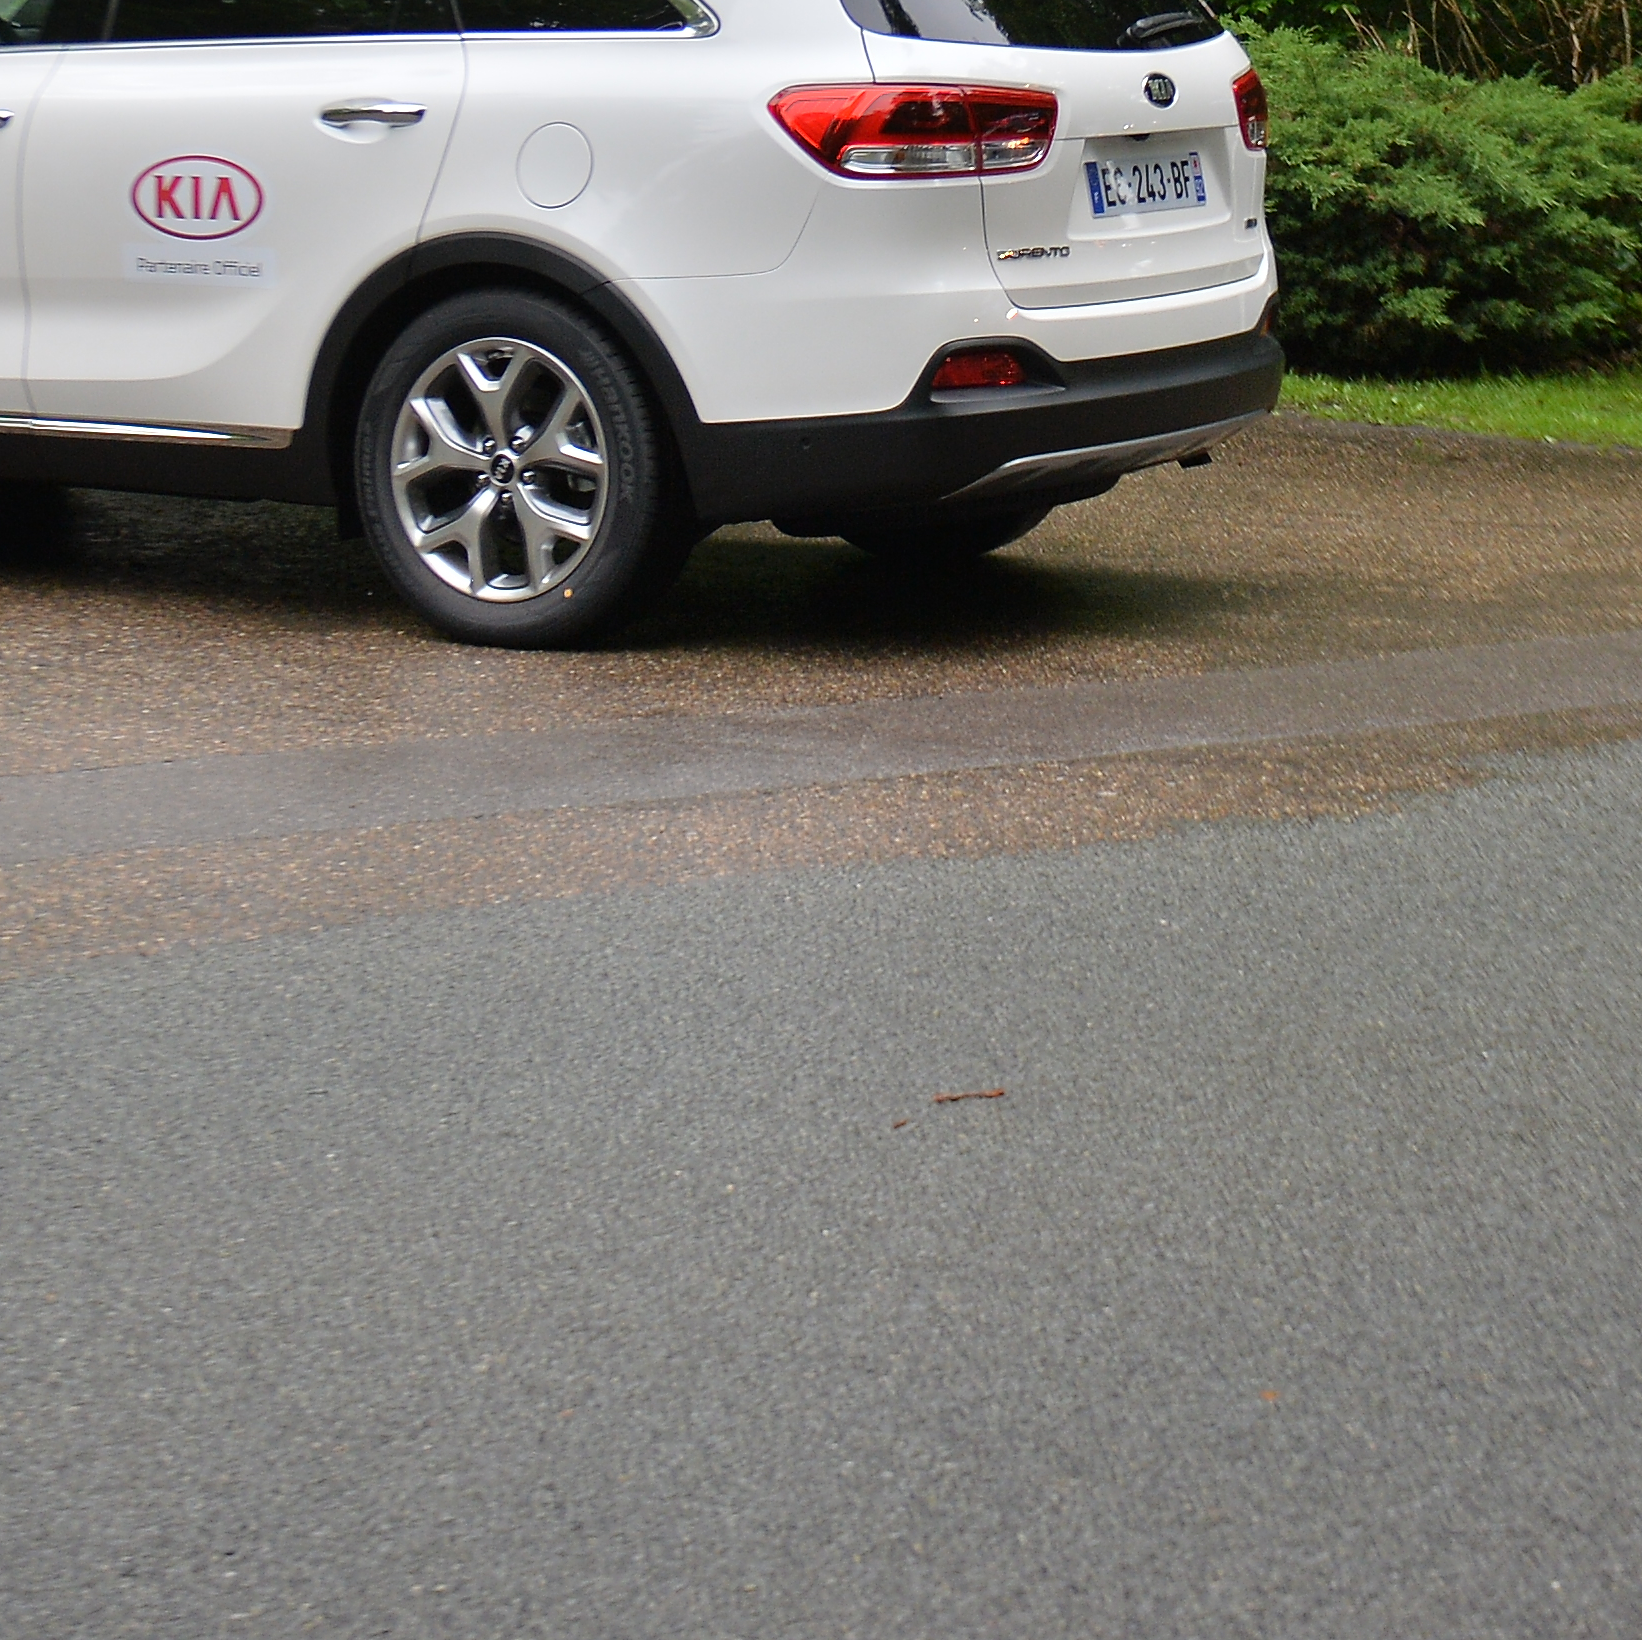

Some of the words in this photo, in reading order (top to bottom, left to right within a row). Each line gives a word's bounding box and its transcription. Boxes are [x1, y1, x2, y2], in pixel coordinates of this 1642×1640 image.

[153, 174, 241, 221] KIA
[136, 257, 211, 275] Partenaire
[214, 260, 263, 277] Officiel
